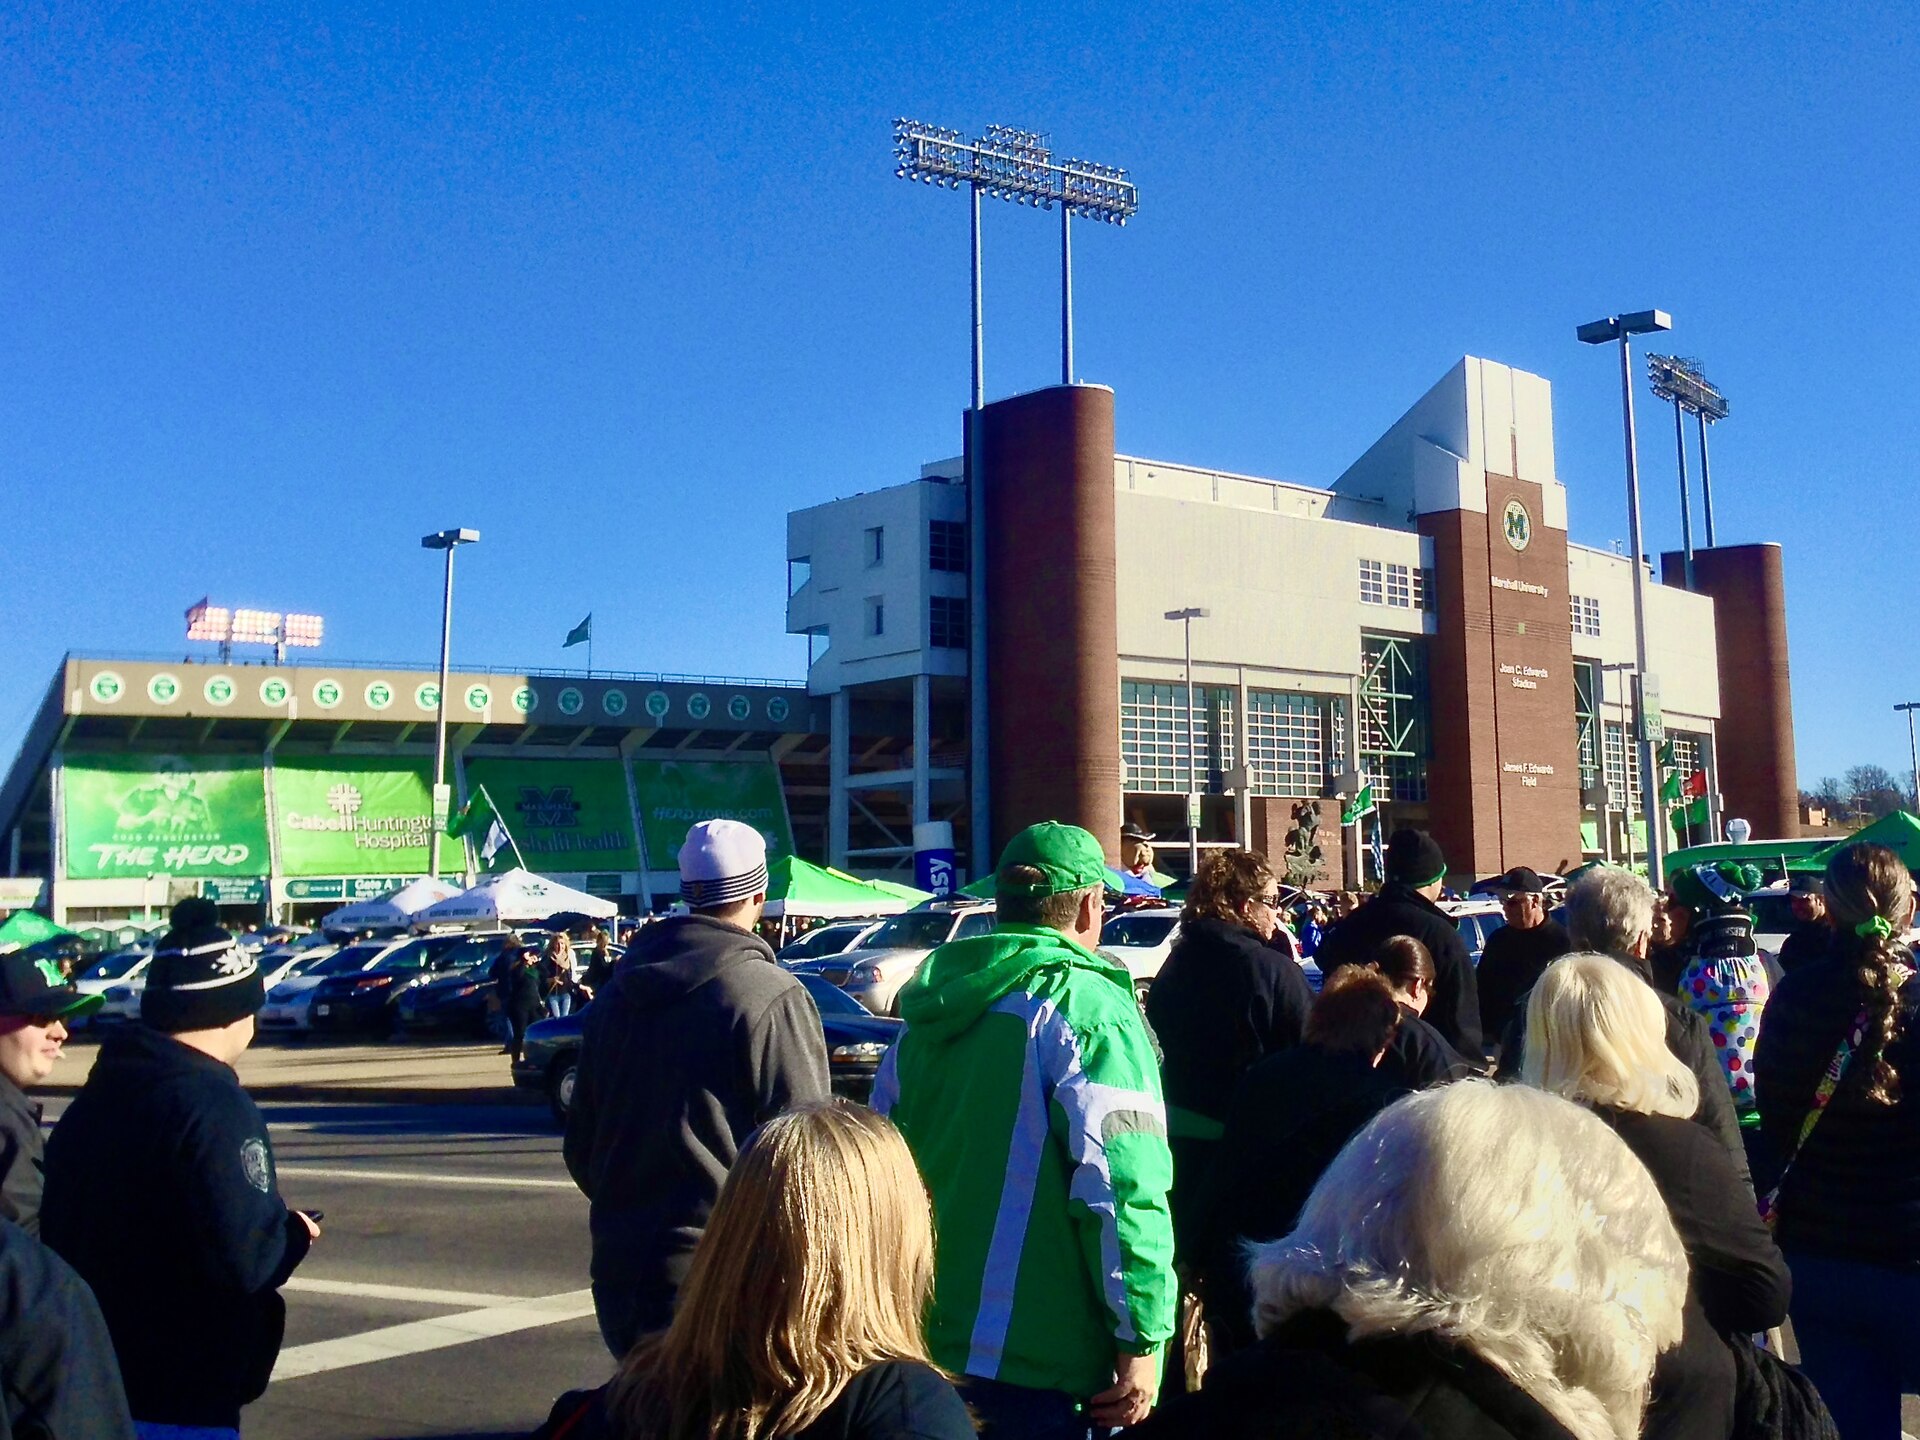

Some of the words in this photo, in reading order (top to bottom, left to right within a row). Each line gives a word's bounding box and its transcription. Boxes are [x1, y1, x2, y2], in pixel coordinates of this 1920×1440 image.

[1491, 575, 1518, 592] Marshall
[1519, 581, 1548, 598] University
[1500, 663, 1514, 674] Joan
[1523, 666, 1548, 678] Edwards
[1512, 677, 1537, 689] Stadium
[1503, 762, 1522, 773] James
[1529, 764, 1553, 775] Edwards
[1521, 776, 1537, 787] Field
[355, 832, 429, 851] Hospital
[89, 842, 158, 870] THE
[162, 843, 249, 871] HERD
[384, 878, 393, 890] A
